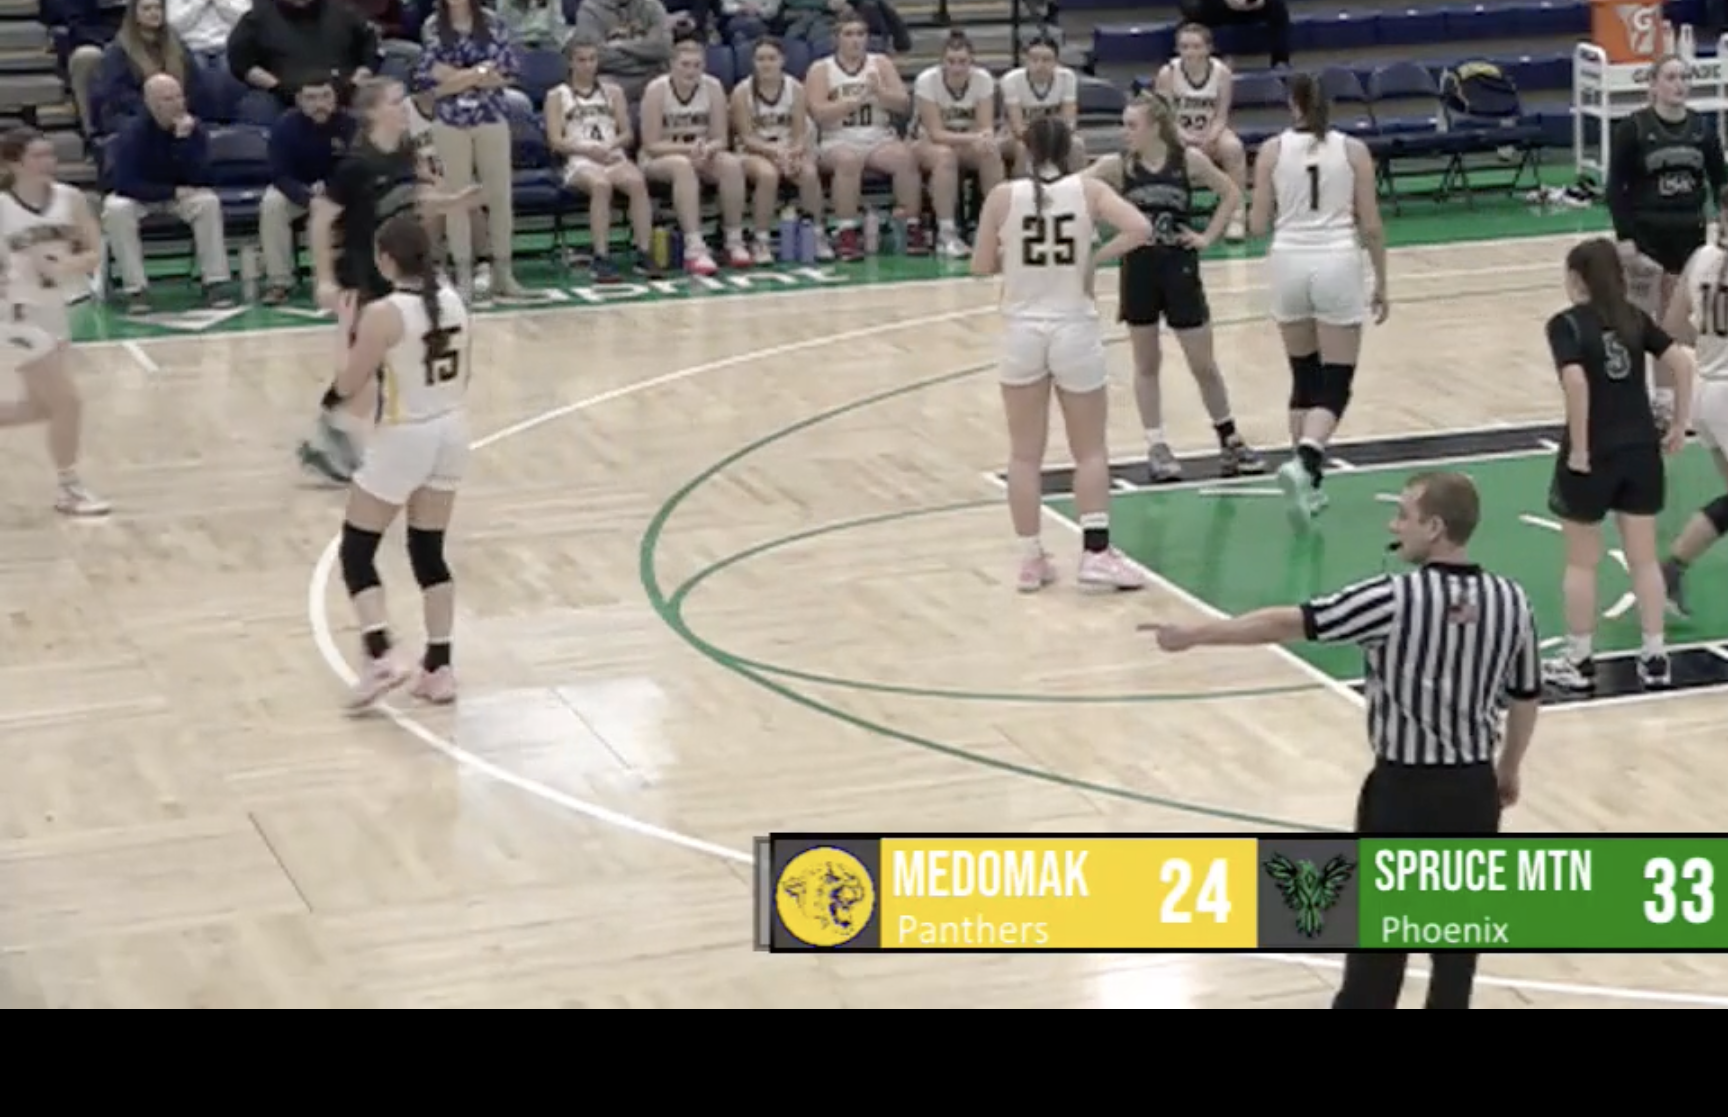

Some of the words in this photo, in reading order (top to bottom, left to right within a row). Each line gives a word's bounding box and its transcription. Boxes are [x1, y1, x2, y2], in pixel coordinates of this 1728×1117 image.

[1306, 164, 1319, 211] 1
[1022, 213, 1075, 266] 25
[422, 325, 461, 385] 15
[1602, 329, 1632, 380] 5
